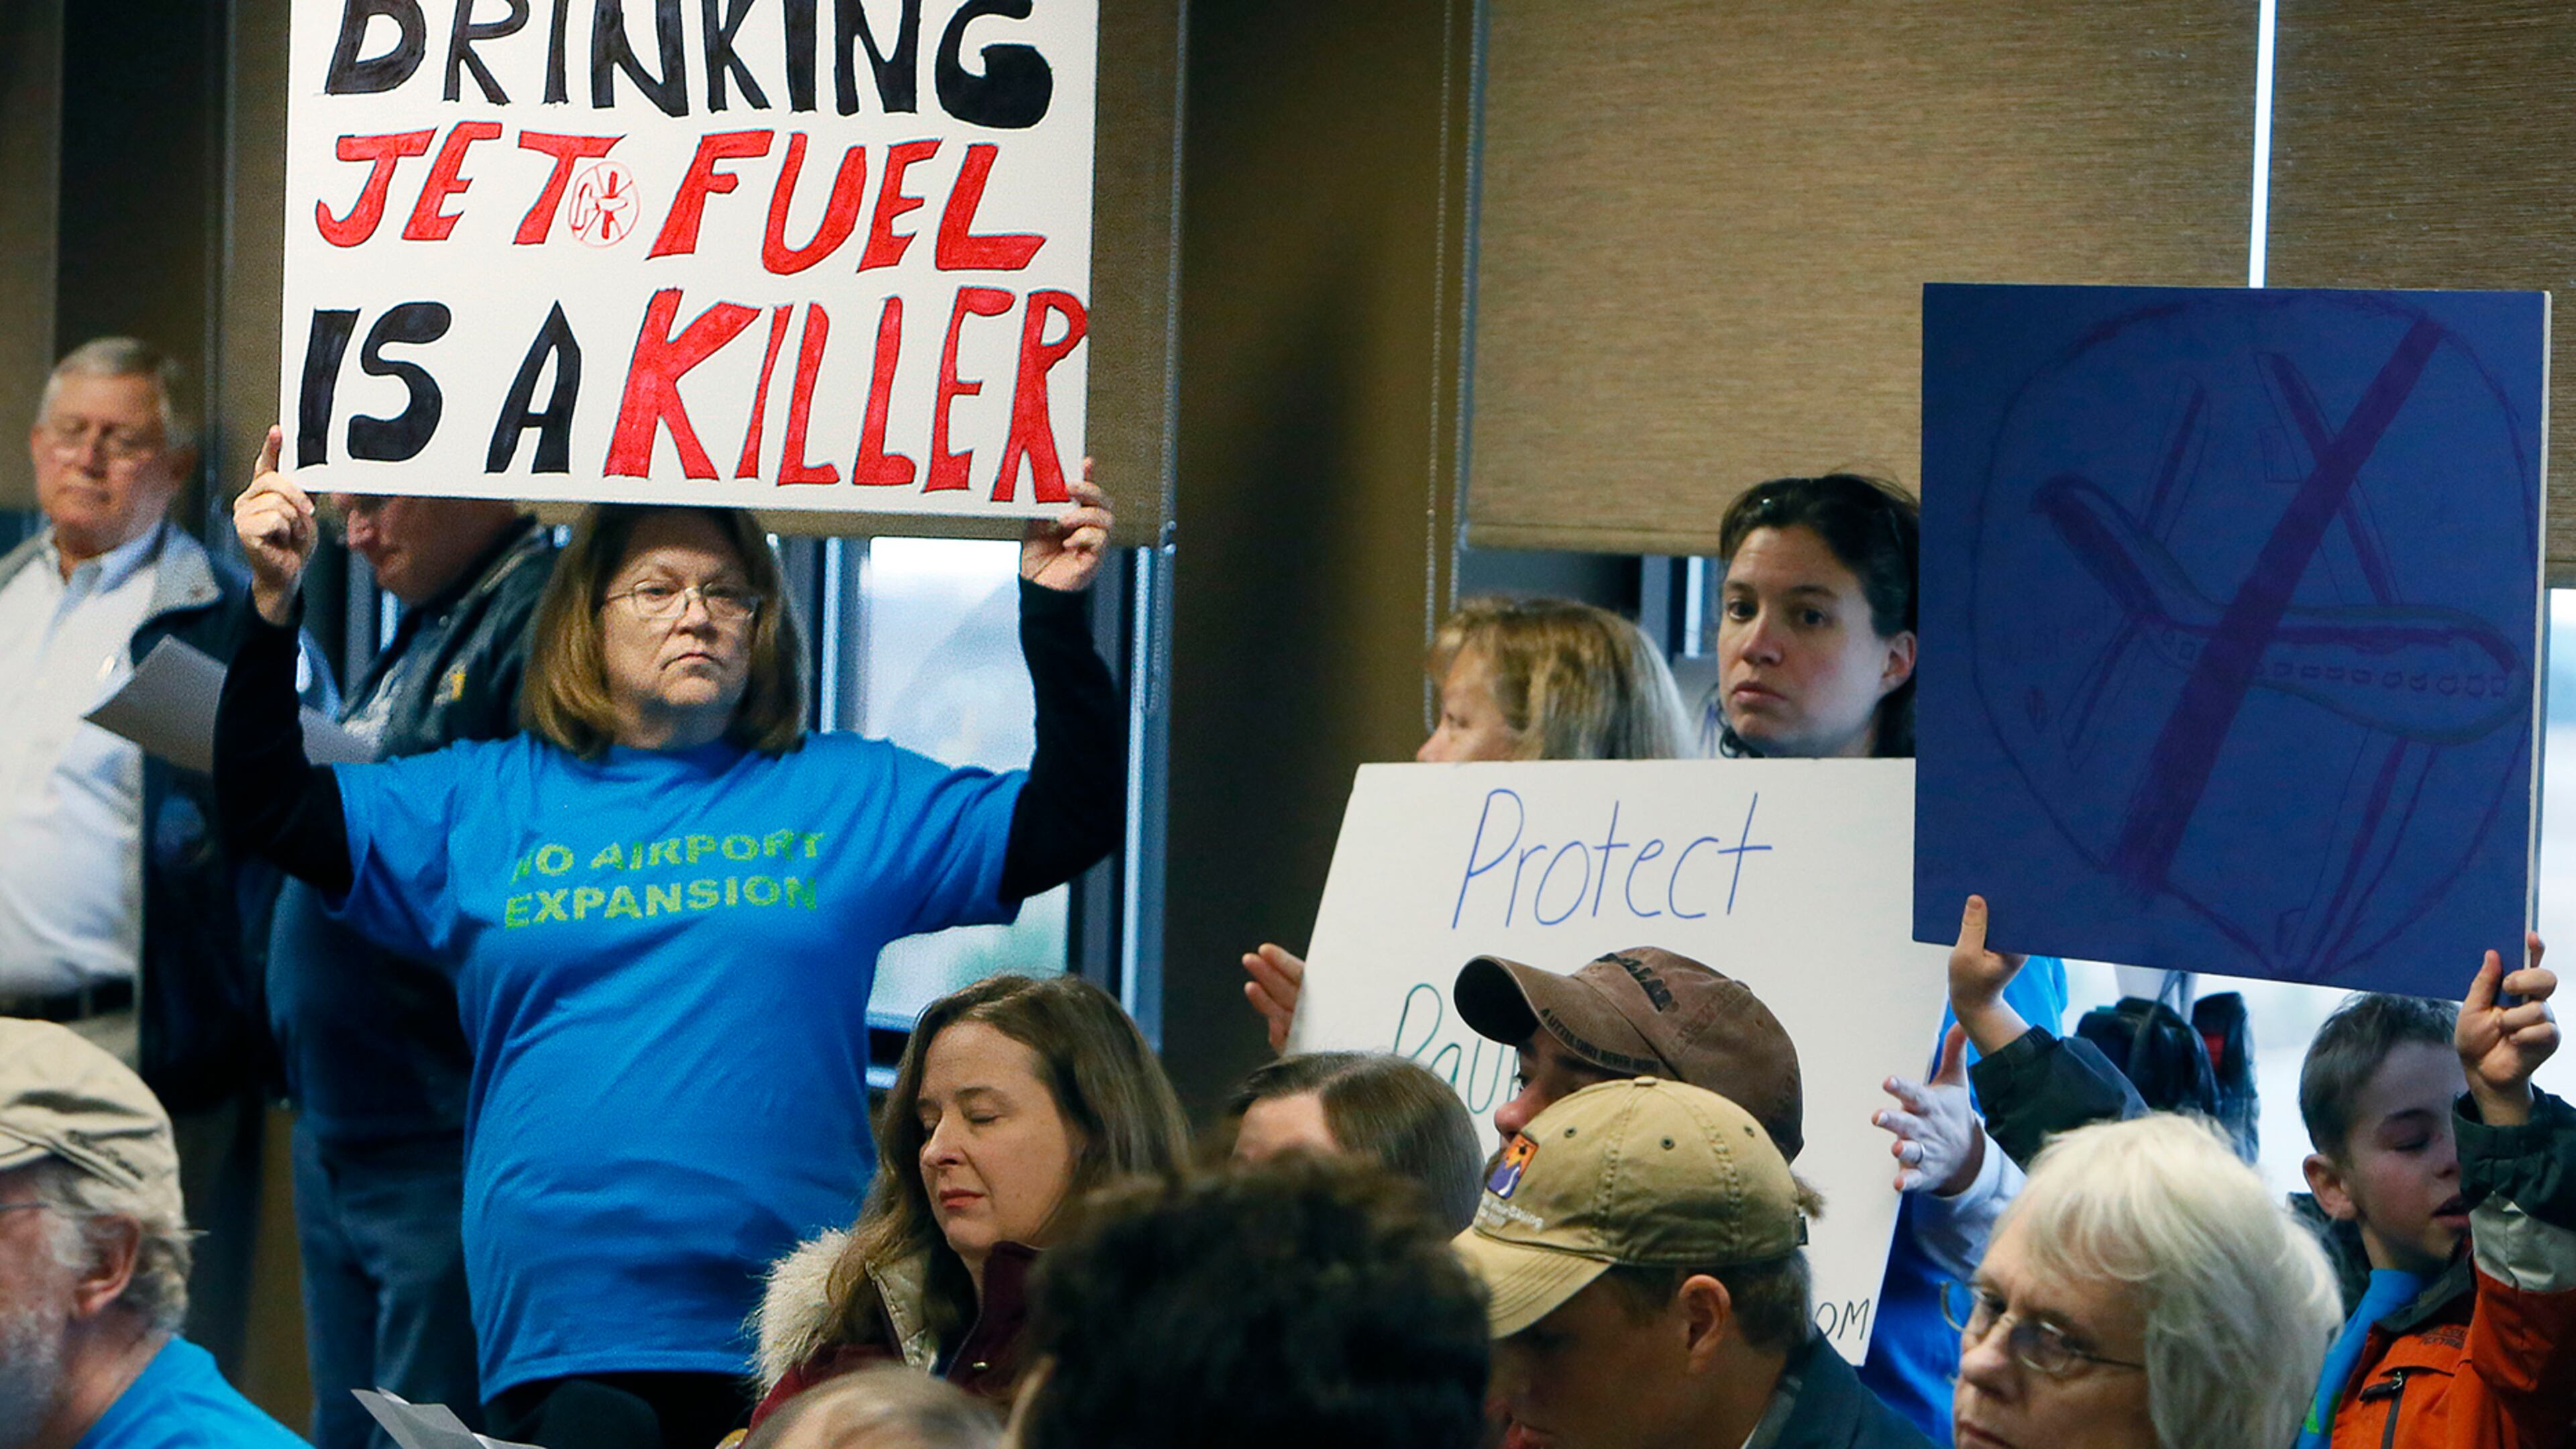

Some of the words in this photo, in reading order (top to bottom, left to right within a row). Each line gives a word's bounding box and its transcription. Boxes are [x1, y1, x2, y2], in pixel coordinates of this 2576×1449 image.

[324, 0, 1053, 129] DRINKING
[315, 121, 626, 248] JET
[646, 129, 1046, 276] FUEL
[297, 302, 451, 470] IS
[484, 301, 582, 474] A
[602, 286, 1088, 503] KILLER
[504, 875, 816, 928] EXPANSION
[590, 828, 826, 871] AIRPORT
[1452, 788, 1772, 929] Protect
